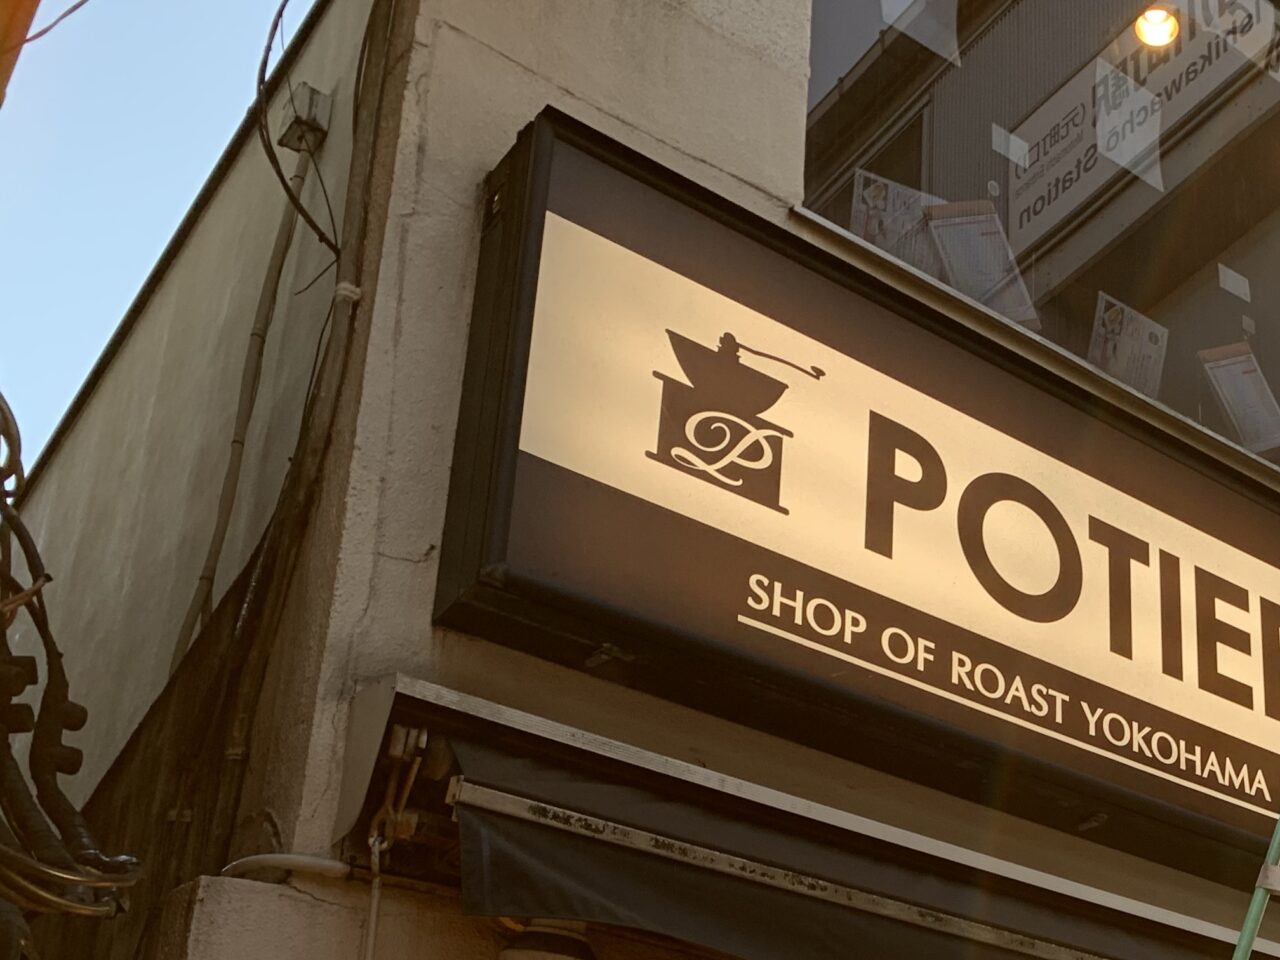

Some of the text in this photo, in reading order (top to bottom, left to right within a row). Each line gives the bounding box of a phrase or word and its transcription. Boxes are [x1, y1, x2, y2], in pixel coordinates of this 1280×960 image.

[746, 573, 868, 642] SHOP
[880, 627, 937, 674] OF
[951, 650, 1070, 724] ROAST
[1079, 706, 1272, 802] YOKOHAMA
